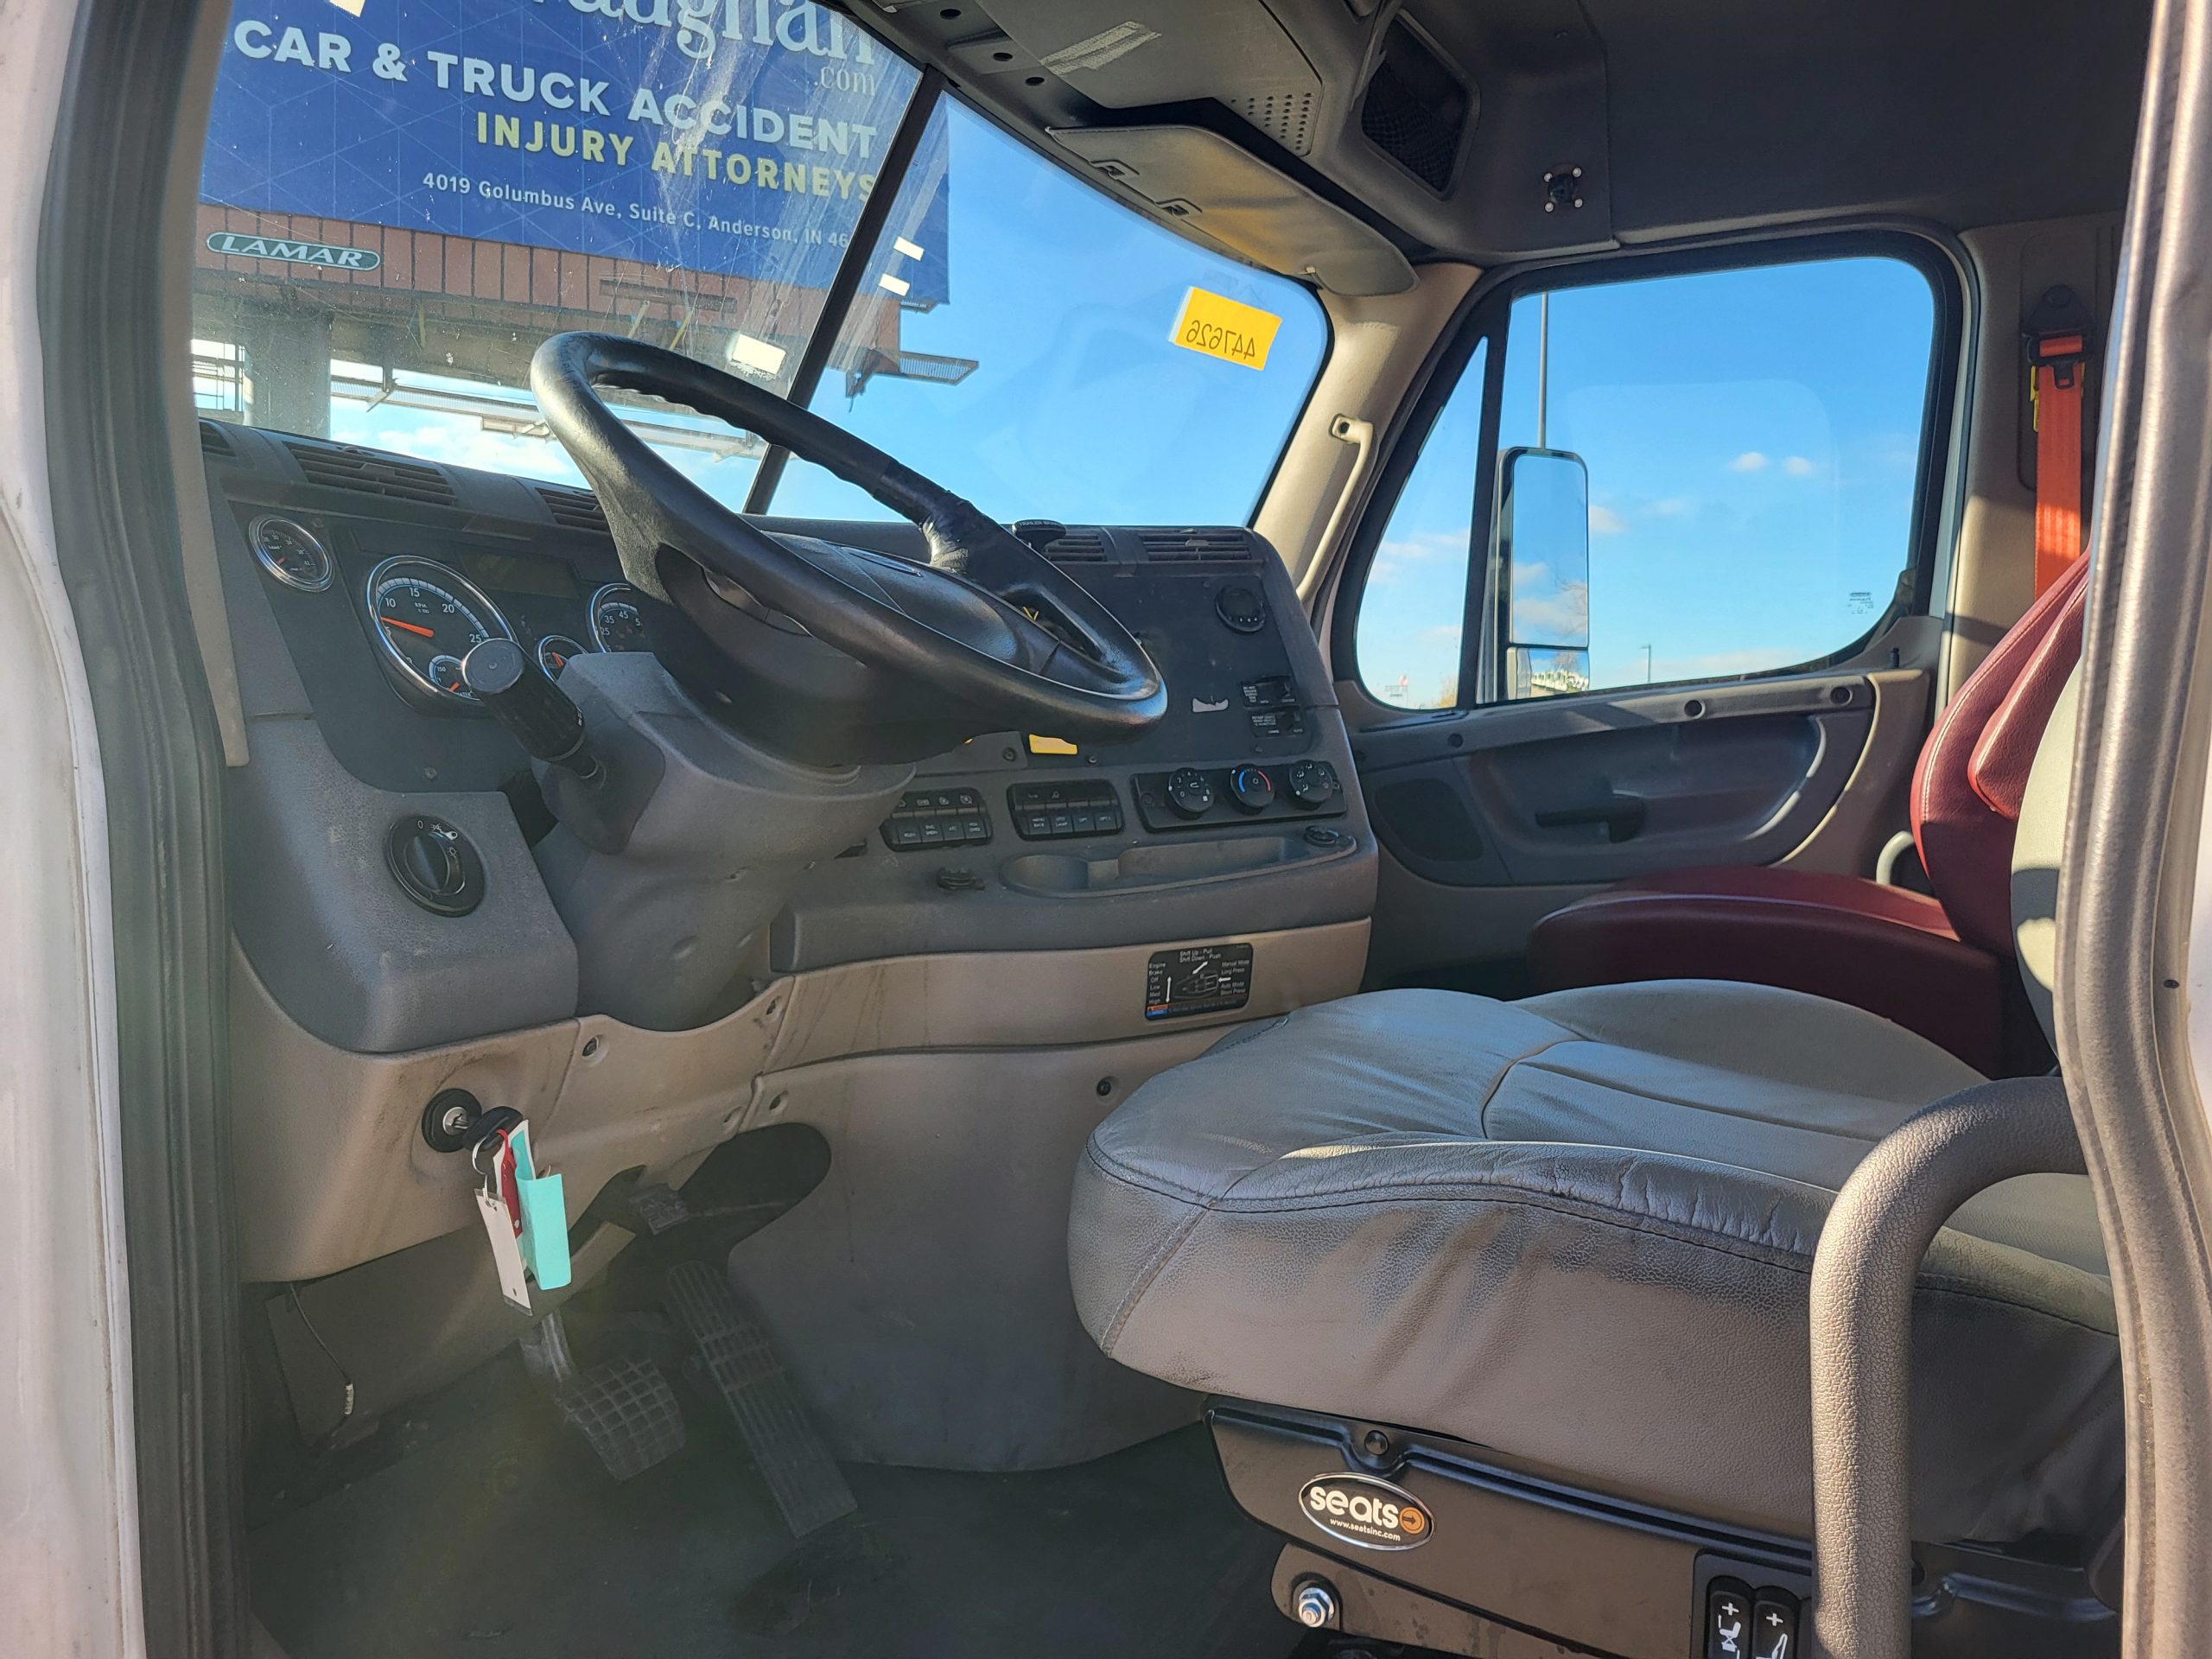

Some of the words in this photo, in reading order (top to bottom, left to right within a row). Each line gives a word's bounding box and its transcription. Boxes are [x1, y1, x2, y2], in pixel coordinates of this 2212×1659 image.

[234, 20, 352, 73] CAR
[372, 42, 408, 82] &
[427, 50, 611, 116] TRUCK
[628, 88, 877, 159] ACCIDENT
[477, 111, 634, 166] INJURY
[651, 141, 877, 202] ATTORNEYS
[423, 172, 471, 194] 4019
[581, 196, 622, 219] Ave,
[629, 203, 677, 226] Suite
[683, 212, 702, 231] C,
[804, 229, 823, 245] IN
[221, 236, 363, 267] LAMAR
[410, 587, 420, 598] 15
[385, 597, 397, 608] 10
[442, 603, 455, 613] 20
[605, 614, 615, 624] 35
[619, 610, 629, 620] 45
[468, 633, 482, 644] 25
[1309, 1486, 1399, 1529] seats
[1330, 1517, 1402, 1542] www.seatsinc.com
